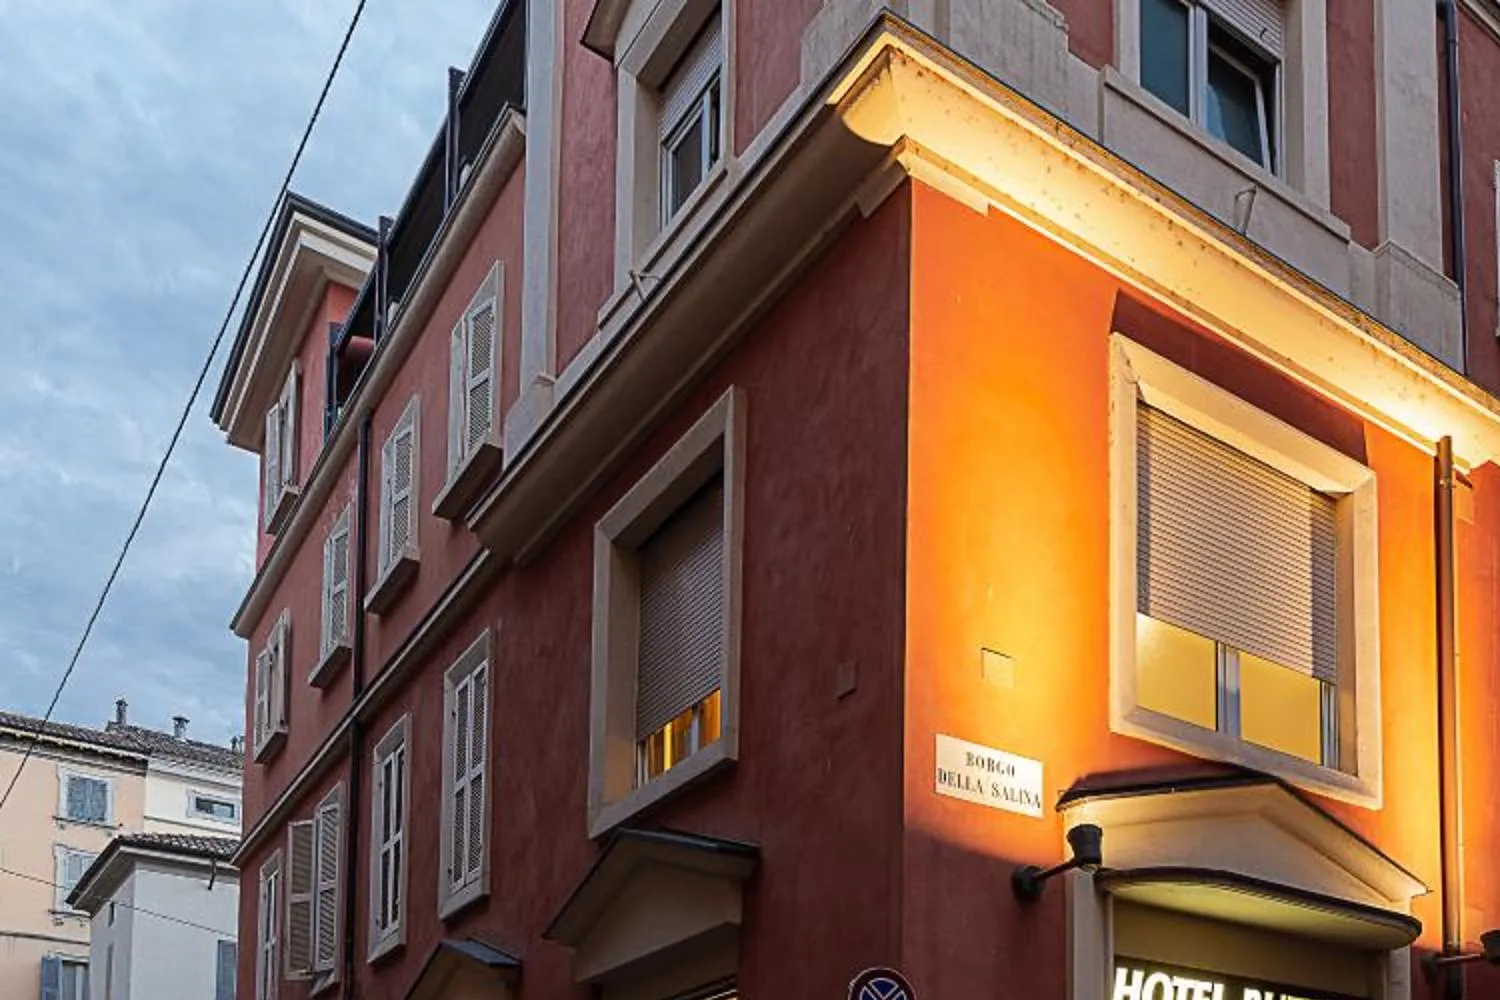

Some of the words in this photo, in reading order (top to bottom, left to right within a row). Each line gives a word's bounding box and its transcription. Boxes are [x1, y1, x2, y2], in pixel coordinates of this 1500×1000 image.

[966, 752, 1015, 777] BORGO
[937, 767, 983, 795] DELLA
[991, 782, 1041, 809] SALINA
